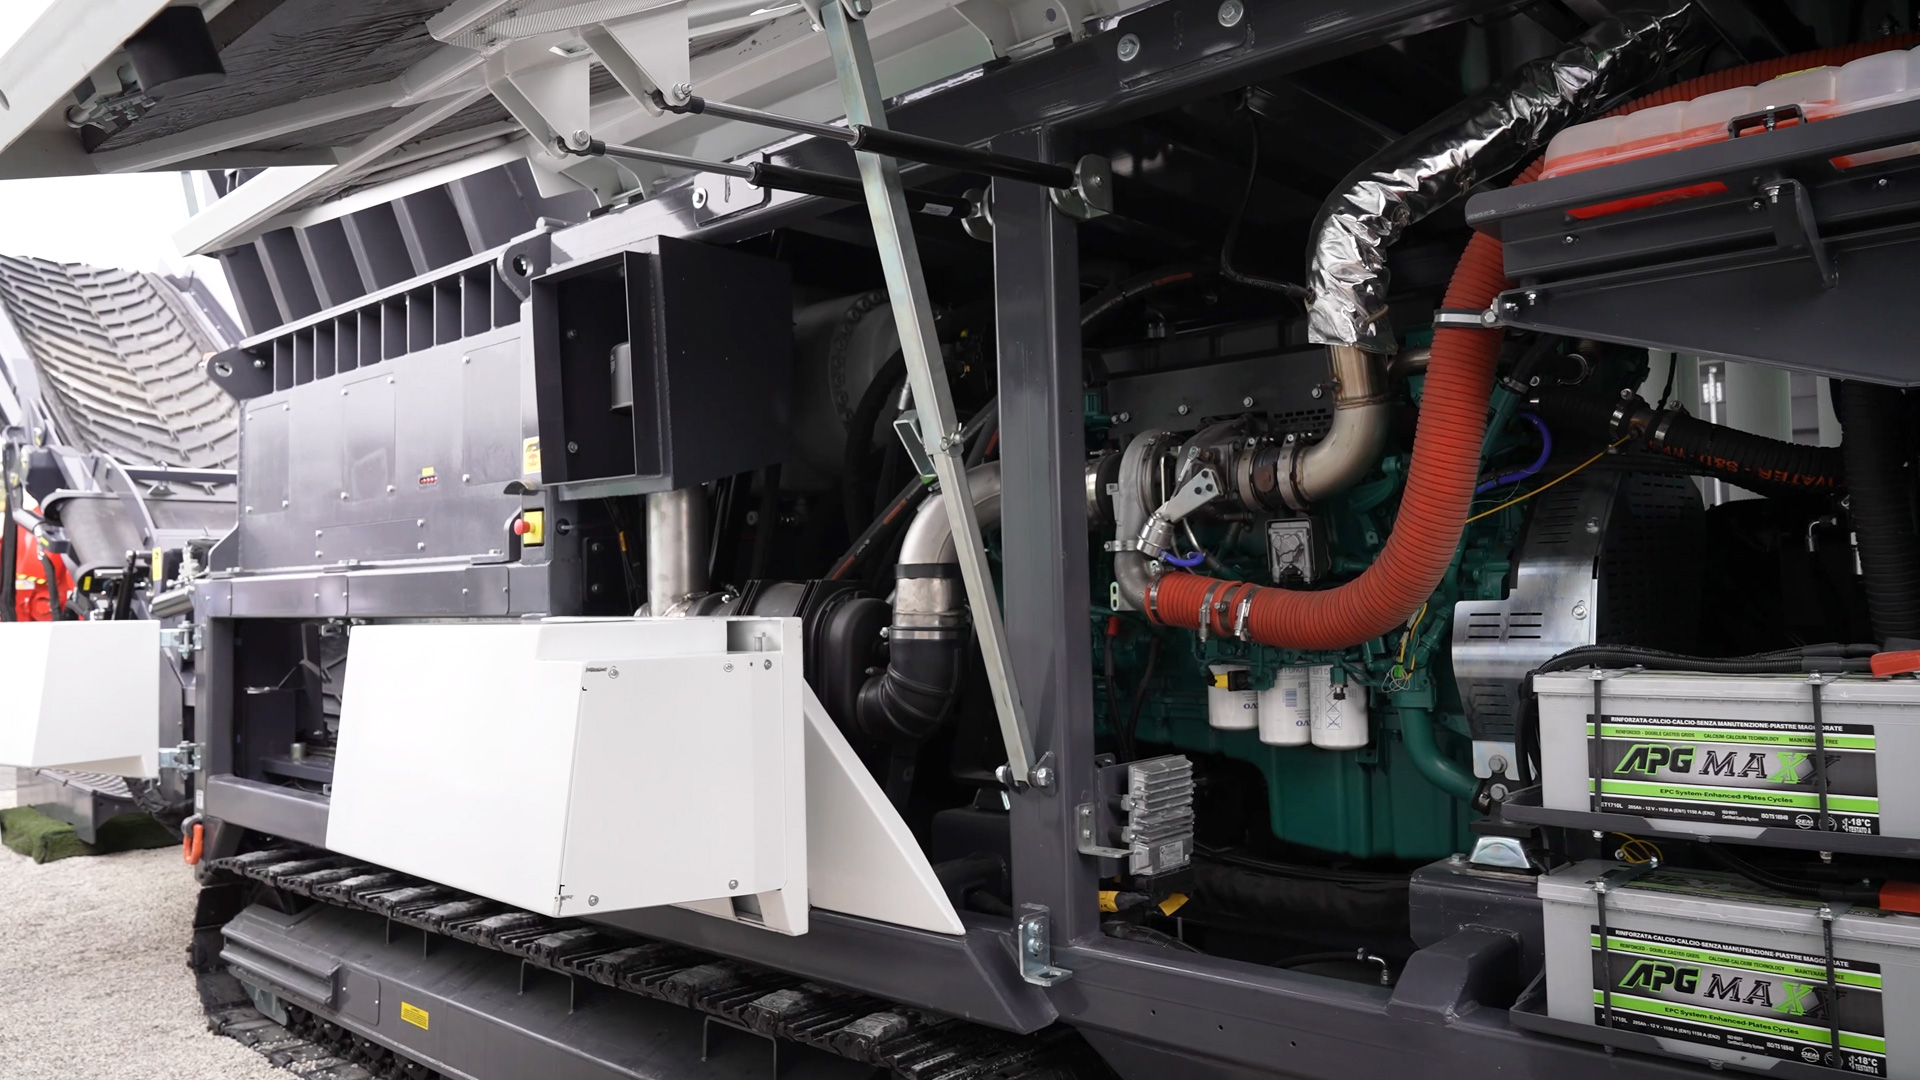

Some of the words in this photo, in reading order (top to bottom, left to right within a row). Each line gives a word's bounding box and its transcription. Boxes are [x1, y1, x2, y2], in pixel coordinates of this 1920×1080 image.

[1798, 724, 1843, 732] MAGORATE
[1614, 744, 1696, 775] APG
[1767, 796, 1793, 804] Cycles
[1803, 956, 1849, 968] MAGGIATE
[1618, 960, 1701, 994] APG
[1794, 968, 1828, 978] MAINTENANC
[1772, 1025, 1799, 1035] Cycles
